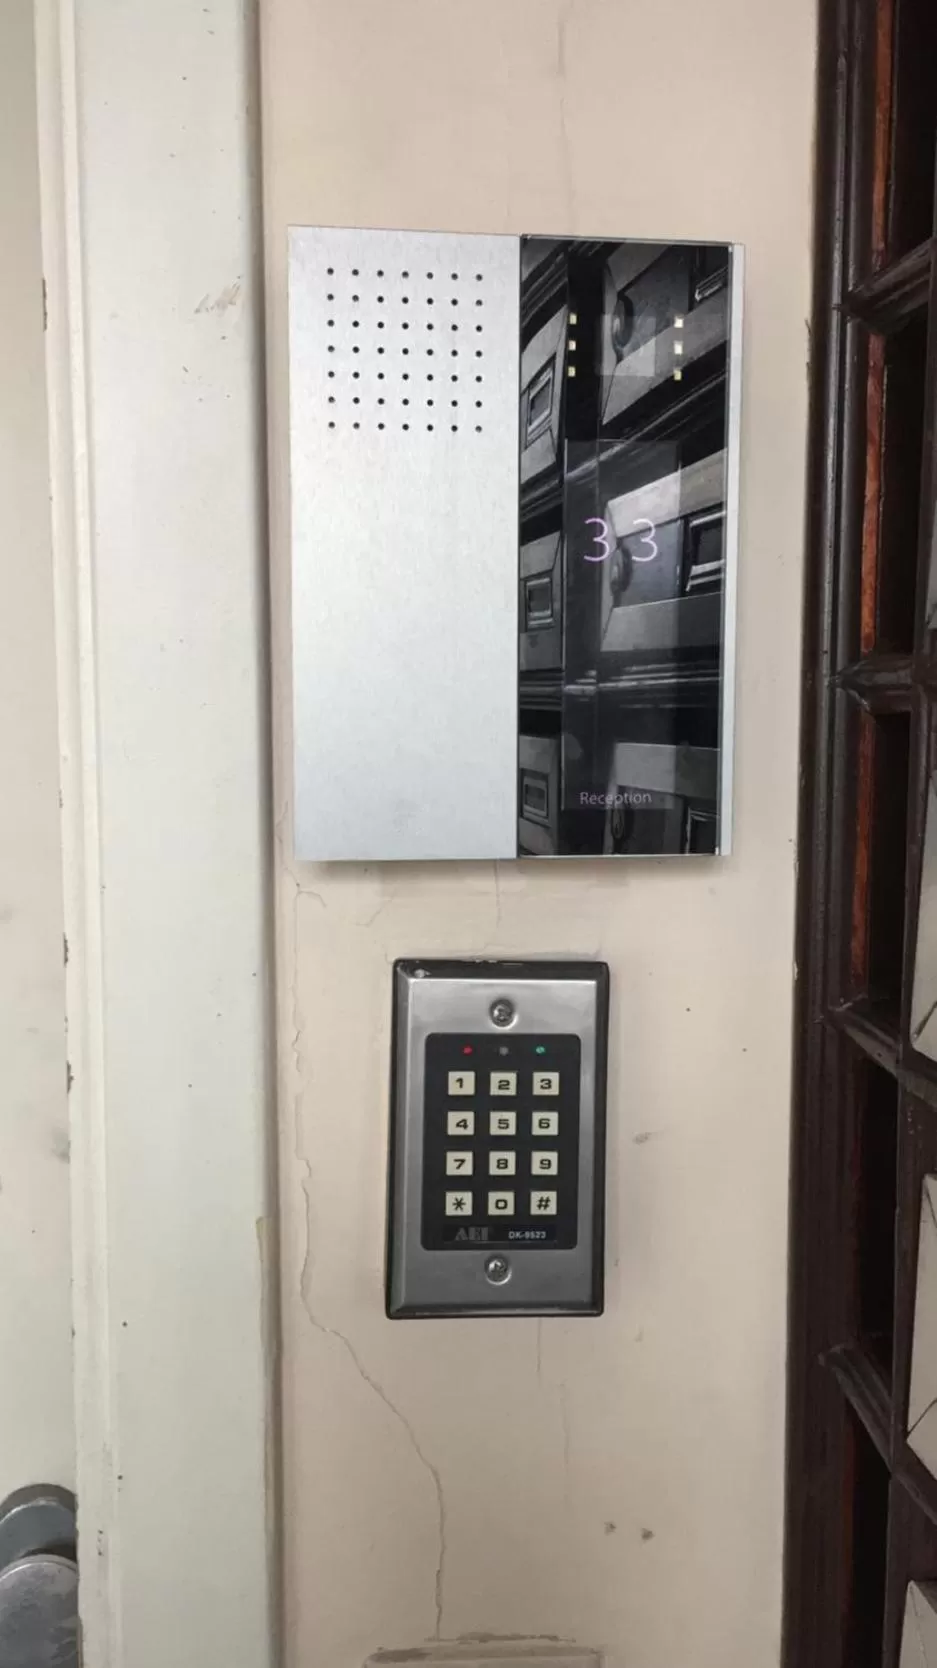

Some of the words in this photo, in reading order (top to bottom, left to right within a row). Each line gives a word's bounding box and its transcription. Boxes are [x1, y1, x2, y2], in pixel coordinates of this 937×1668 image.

[579, 790, 653, 808] Reception
[497, 1079, 511, 1091] 2
[539, 1078, 553, 1090] 3
[455, 1118, 469, 1130] 4
[497, 1118, 510, 1130] 5
[538, 1117, 551, 1130] 6
[453, 1158, 467, 1170] 7
[495, 1157, 509, 1171] 8
[539, 1158, 552, 1170] 9
